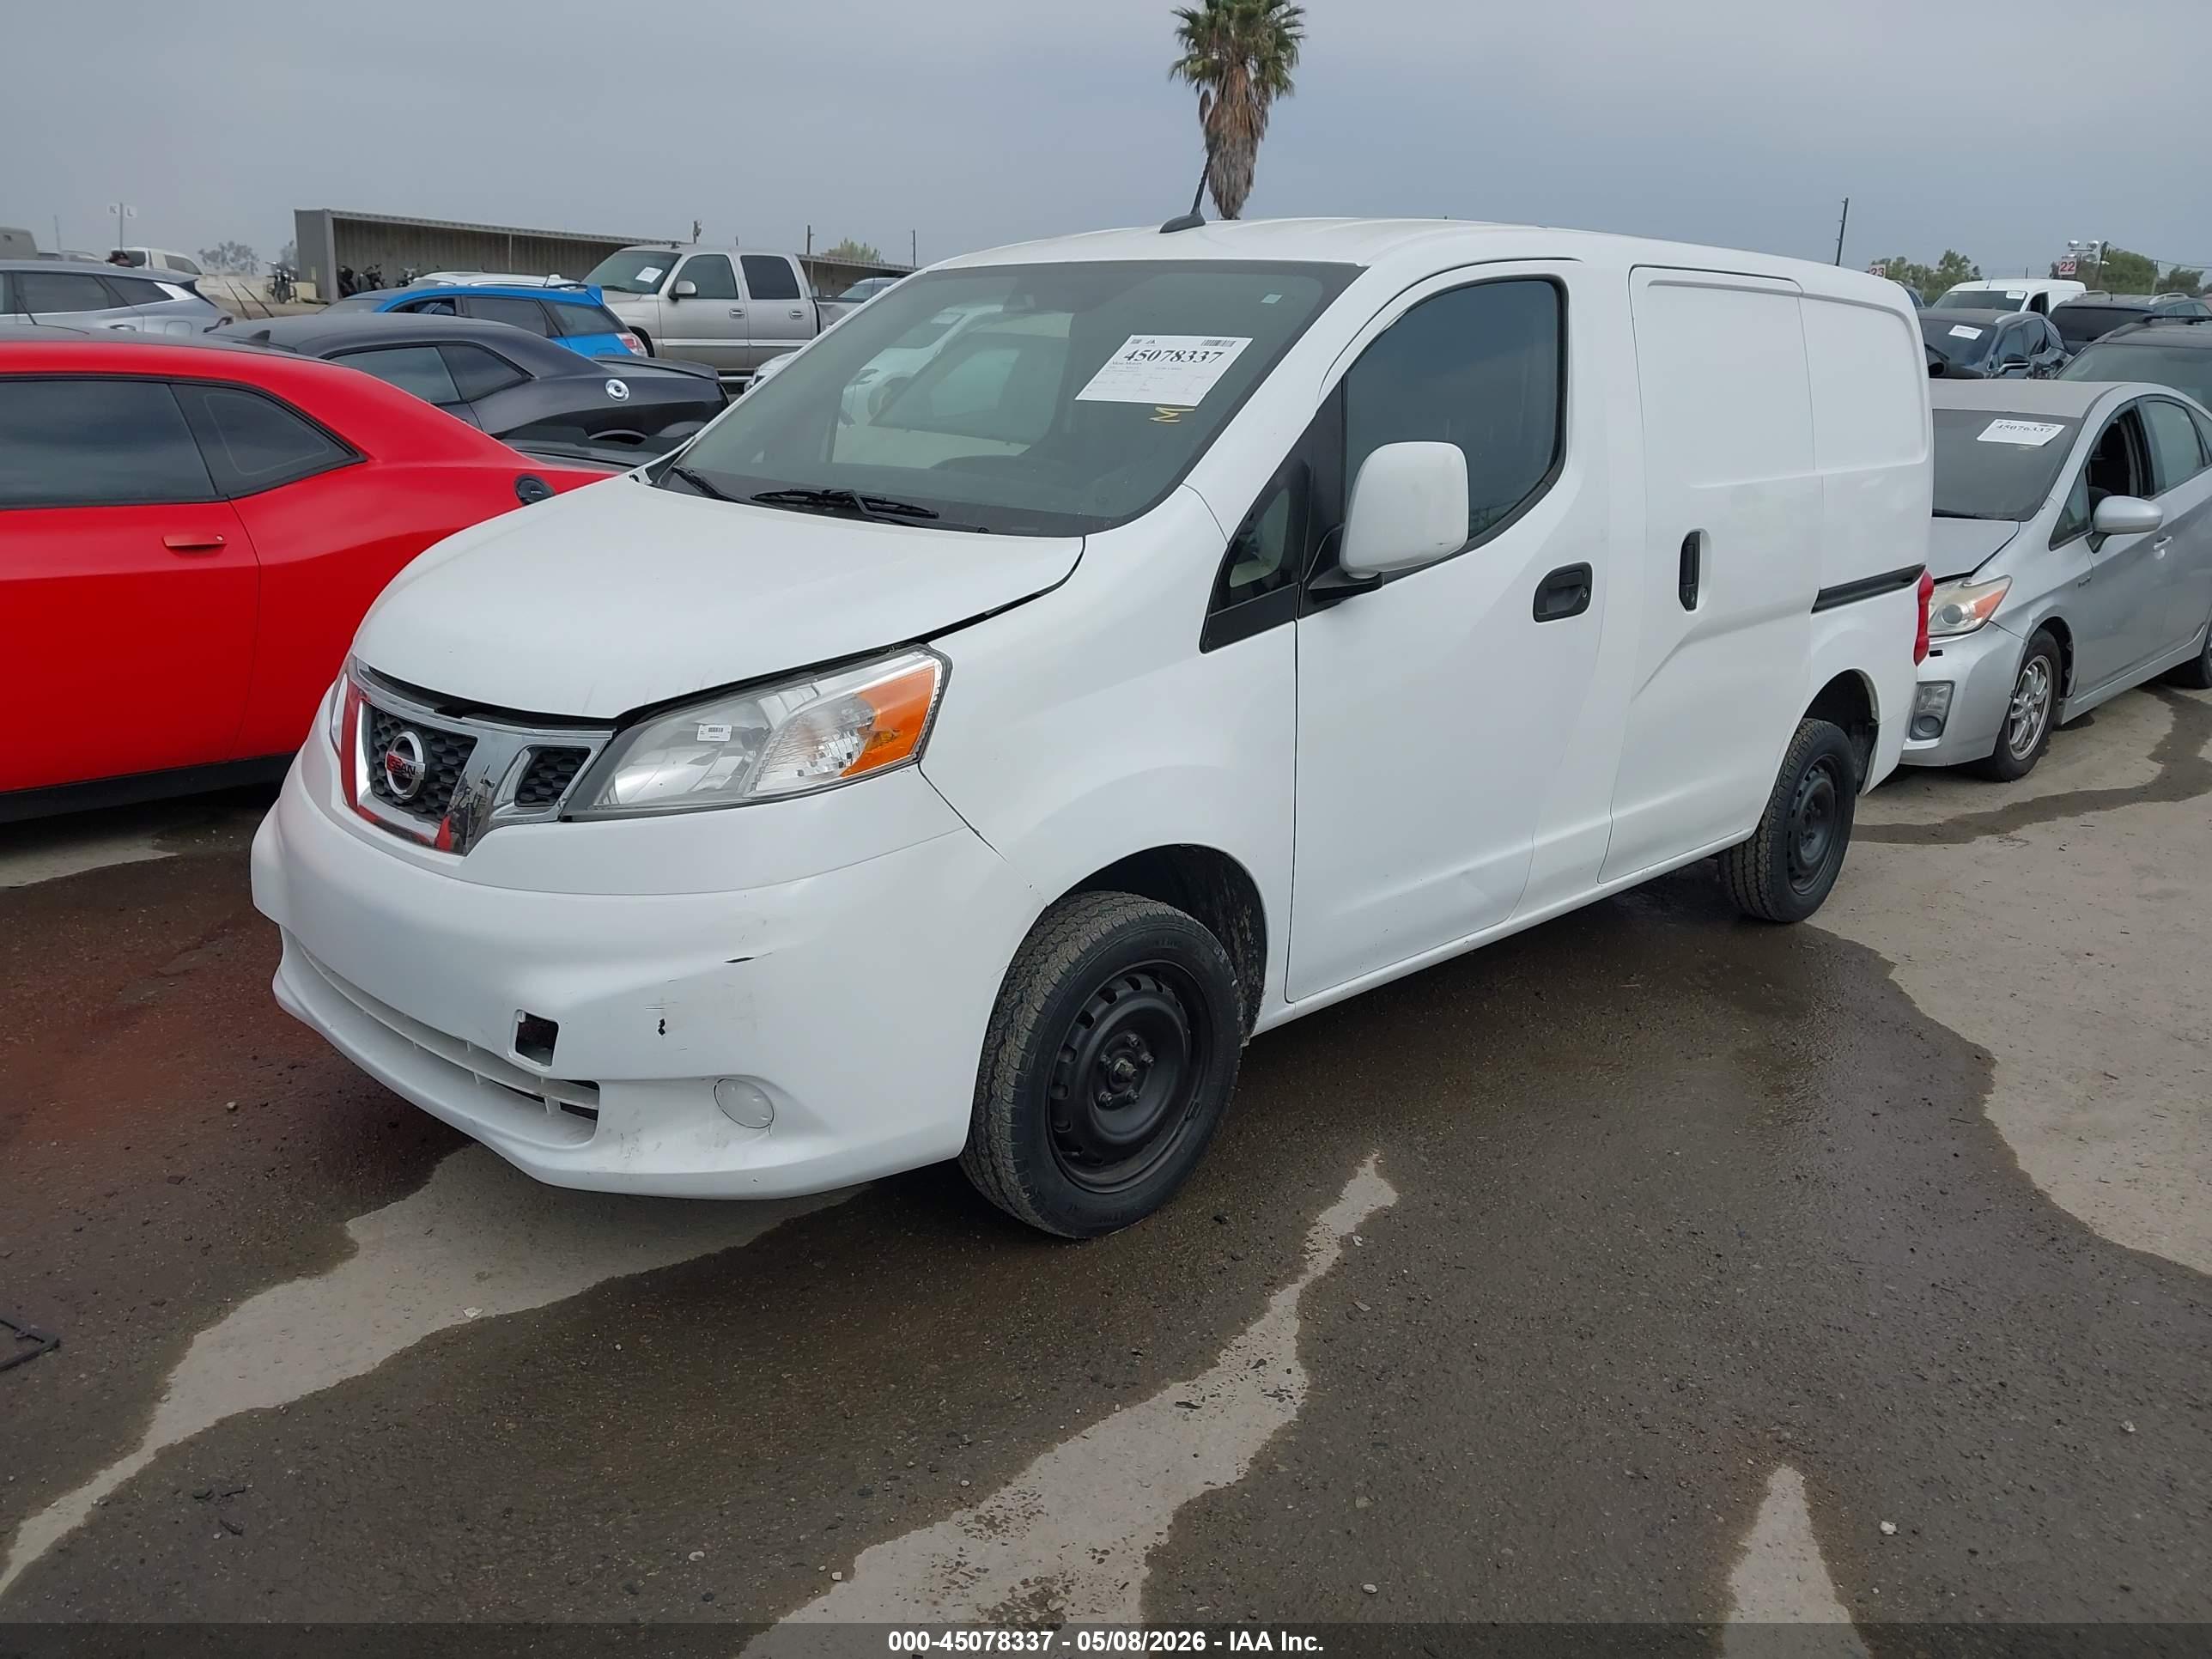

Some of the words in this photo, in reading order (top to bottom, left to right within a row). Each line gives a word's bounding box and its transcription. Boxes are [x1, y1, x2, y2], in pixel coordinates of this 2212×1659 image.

[2060, 261, 2075, 271] 22
[1123, 349, 1225, 364] 45078337
[387, 755, 416, 776] SSAN
